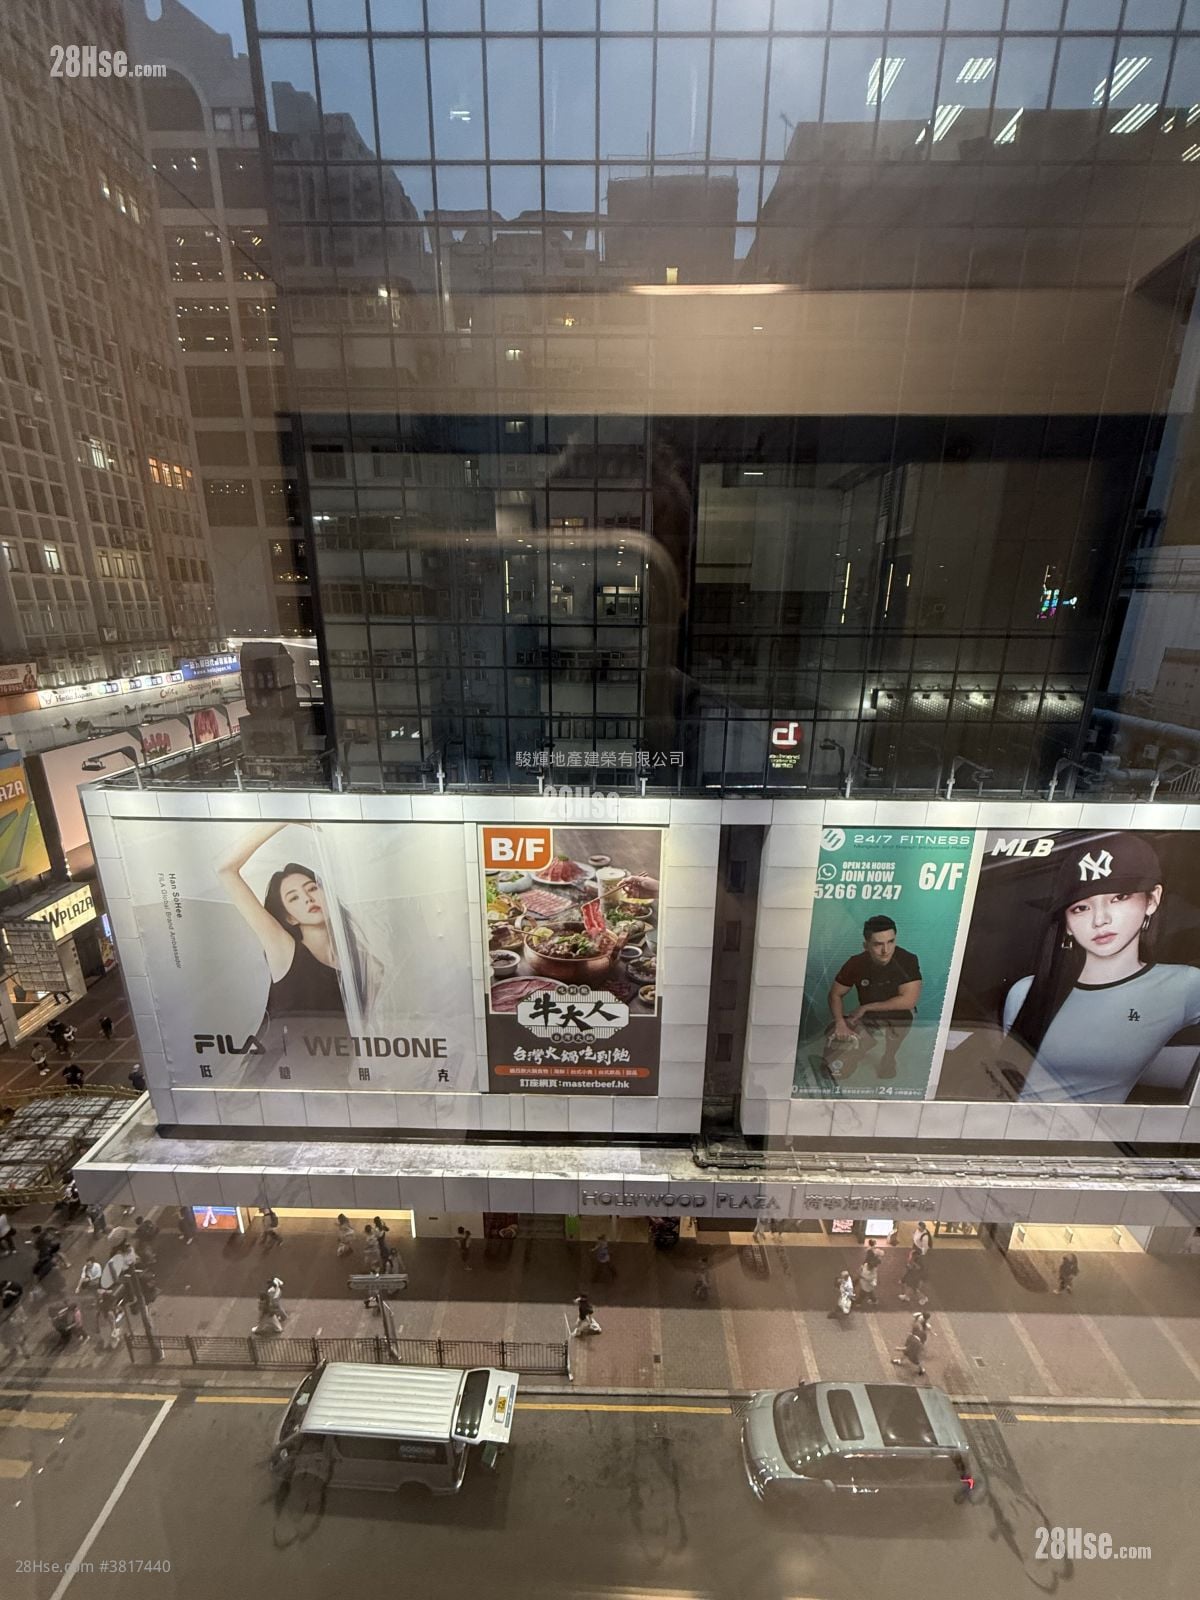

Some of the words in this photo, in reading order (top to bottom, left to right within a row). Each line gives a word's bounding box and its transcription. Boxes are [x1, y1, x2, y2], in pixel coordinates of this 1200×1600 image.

[853, 834, 893, 844] 24/7
[900, 834, 970, 845] FITNESS
[991, 838, 1055, 857] MLB
[490, 837, 545, 862] B/F
[842, 861, 861, 870] OPEN
[861, 862, 871, 870] 24
[871, 862, 896, 870] HOURS
[168, 873, 177, 889] Han
[840, 870, 865, 882] JOIN
[866, 870, 895, 883] NOW
[918, 862, 965, 891] 6/F
[814, 883, 857, 899] 5266
[861, 884, 903, 900] 0247
[172, 892, 182, 918] SoHee
[529, 993, 621, 1032] 牛大人
[194, 1034, 266, 1054] FILA
[512, 1045, 630, 1065] 台灣火鍋吃到飽
[878, 1086, 893, 1095] 24
